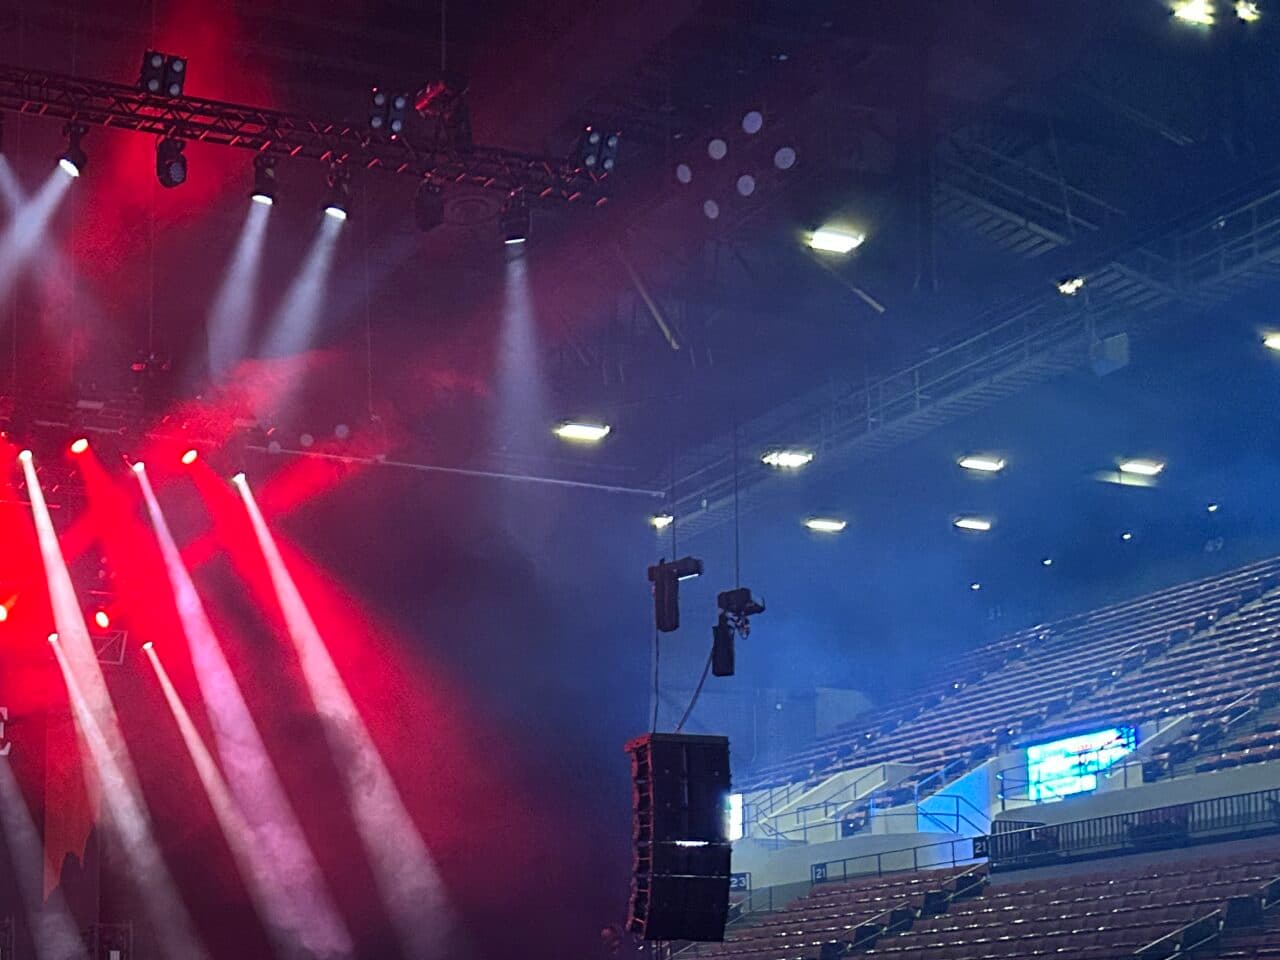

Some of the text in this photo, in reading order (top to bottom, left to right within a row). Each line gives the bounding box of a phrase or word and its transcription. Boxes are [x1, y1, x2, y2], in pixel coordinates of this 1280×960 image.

[975, 841, 987, 853] 21
[816, 867, 826, 879] 21
[730, 877, 746, 888] 23
